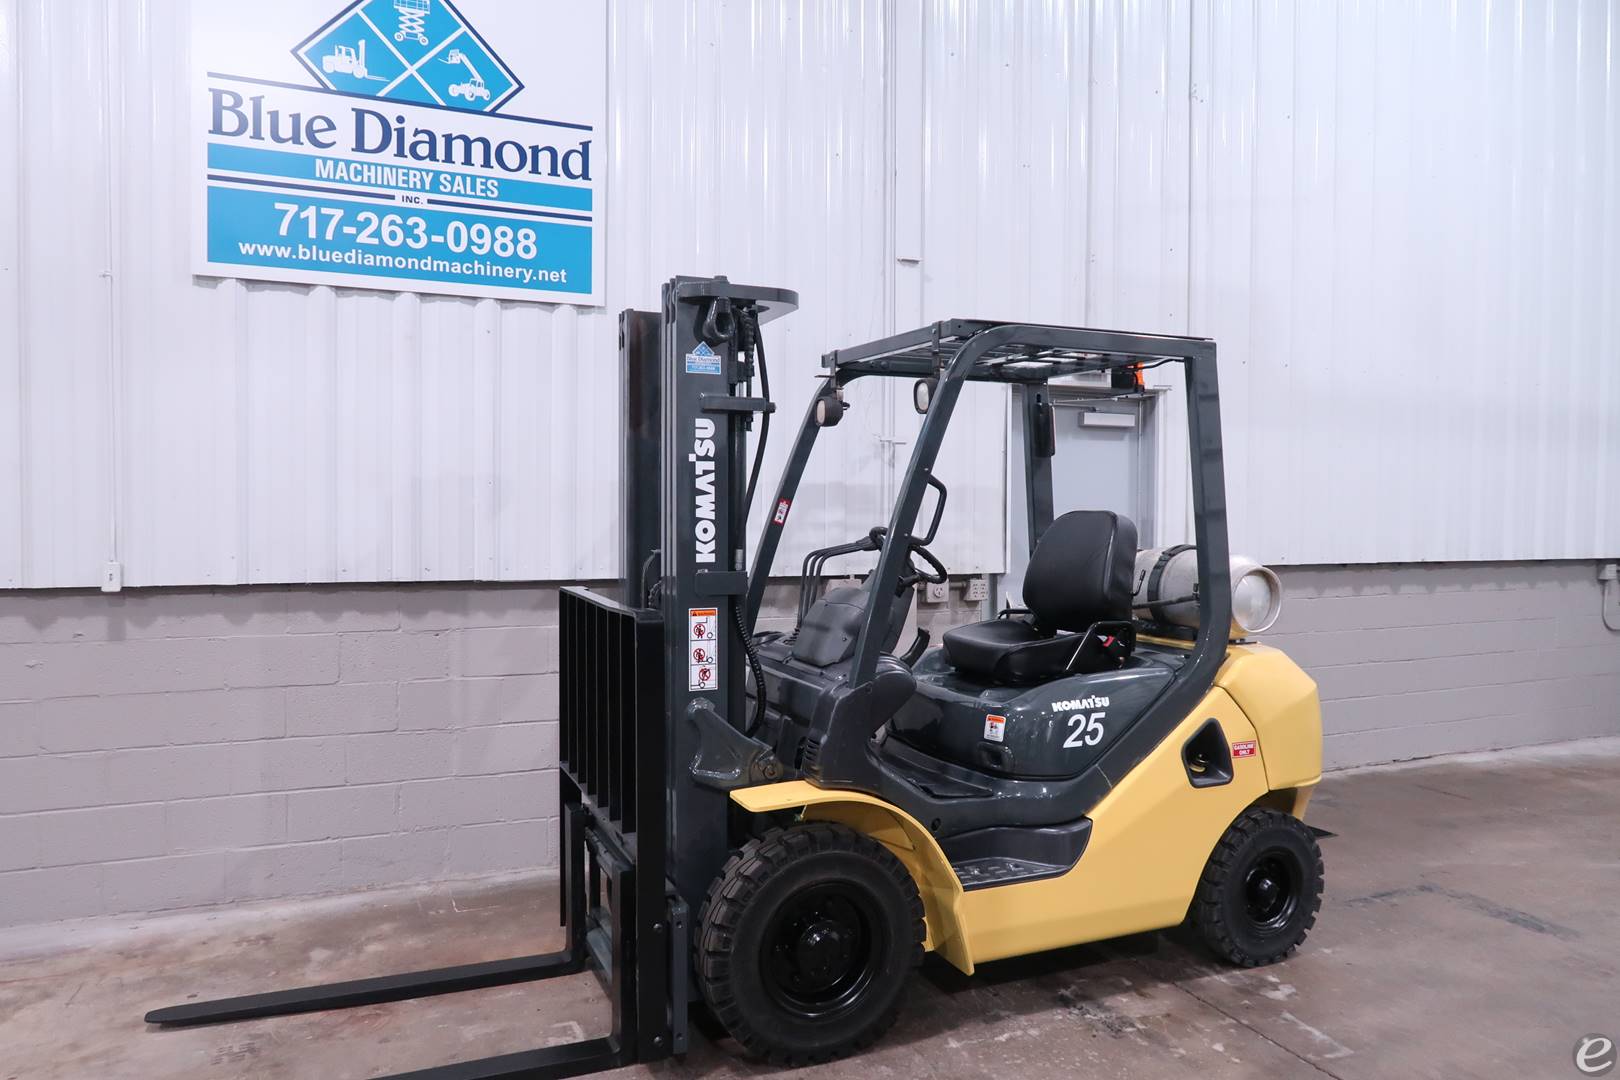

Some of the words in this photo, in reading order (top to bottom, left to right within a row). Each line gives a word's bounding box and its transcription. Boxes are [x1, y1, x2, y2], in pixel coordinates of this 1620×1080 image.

[208, 88, 337, 149] Blue
[351, 107, 592, 181] Diamond
[315, 158, 434, 191] MACHINERY
[439, 173, 499, 198] SALES
[401, 194, 424, 205] INC.
[274, 202, 538, 260] 717-263-0988
[238, 241, 568, 284] www.bluediamondmachinery.net
[689, 418, 716, 563] KOMATSU
[1051, 695, 1110, 713] KOMATSU
[1063, 712, 1106, 748] 25
